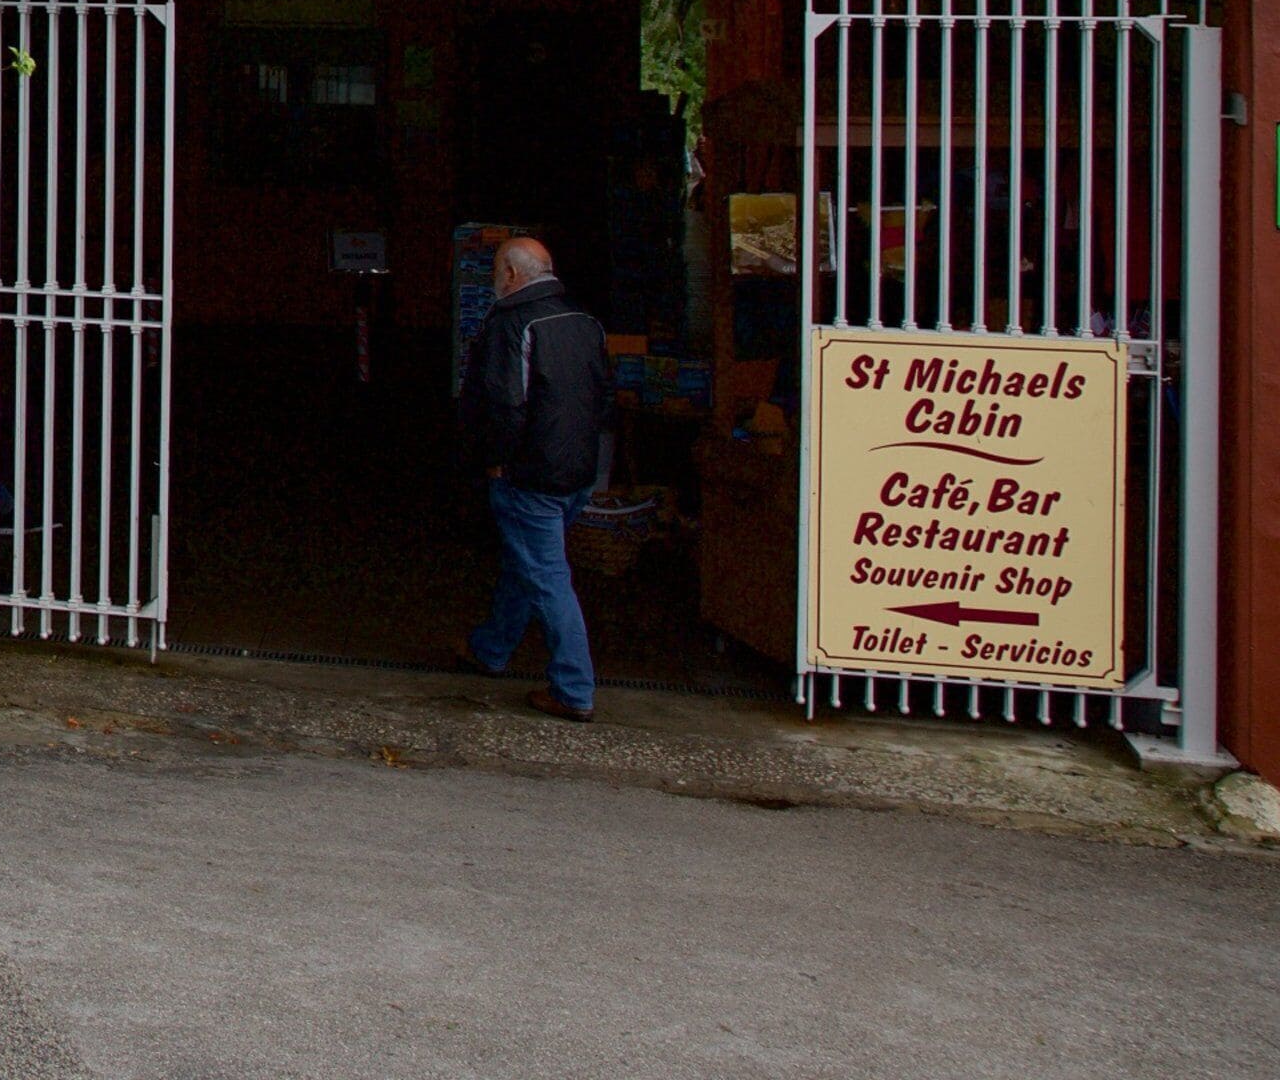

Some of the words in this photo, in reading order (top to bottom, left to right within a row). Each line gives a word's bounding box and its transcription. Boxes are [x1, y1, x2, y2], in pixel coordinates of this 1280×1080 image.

[845, 354, 890, 390] St
[904, 358, 1086, 399] Michaels
[905, 398, 1022, 438] Cabin
[880, 472, 980, 516] Café,
[987, 478, 1061, 517] Bar
[853, 512, 1069, 558] Restaurant
[850, 557, 985, 592] Souvenir
[995, 567, 1072, 605] Shop
[853, 626, 928, 655] Toilet
[961, 634, 1093, 668] Servicios
